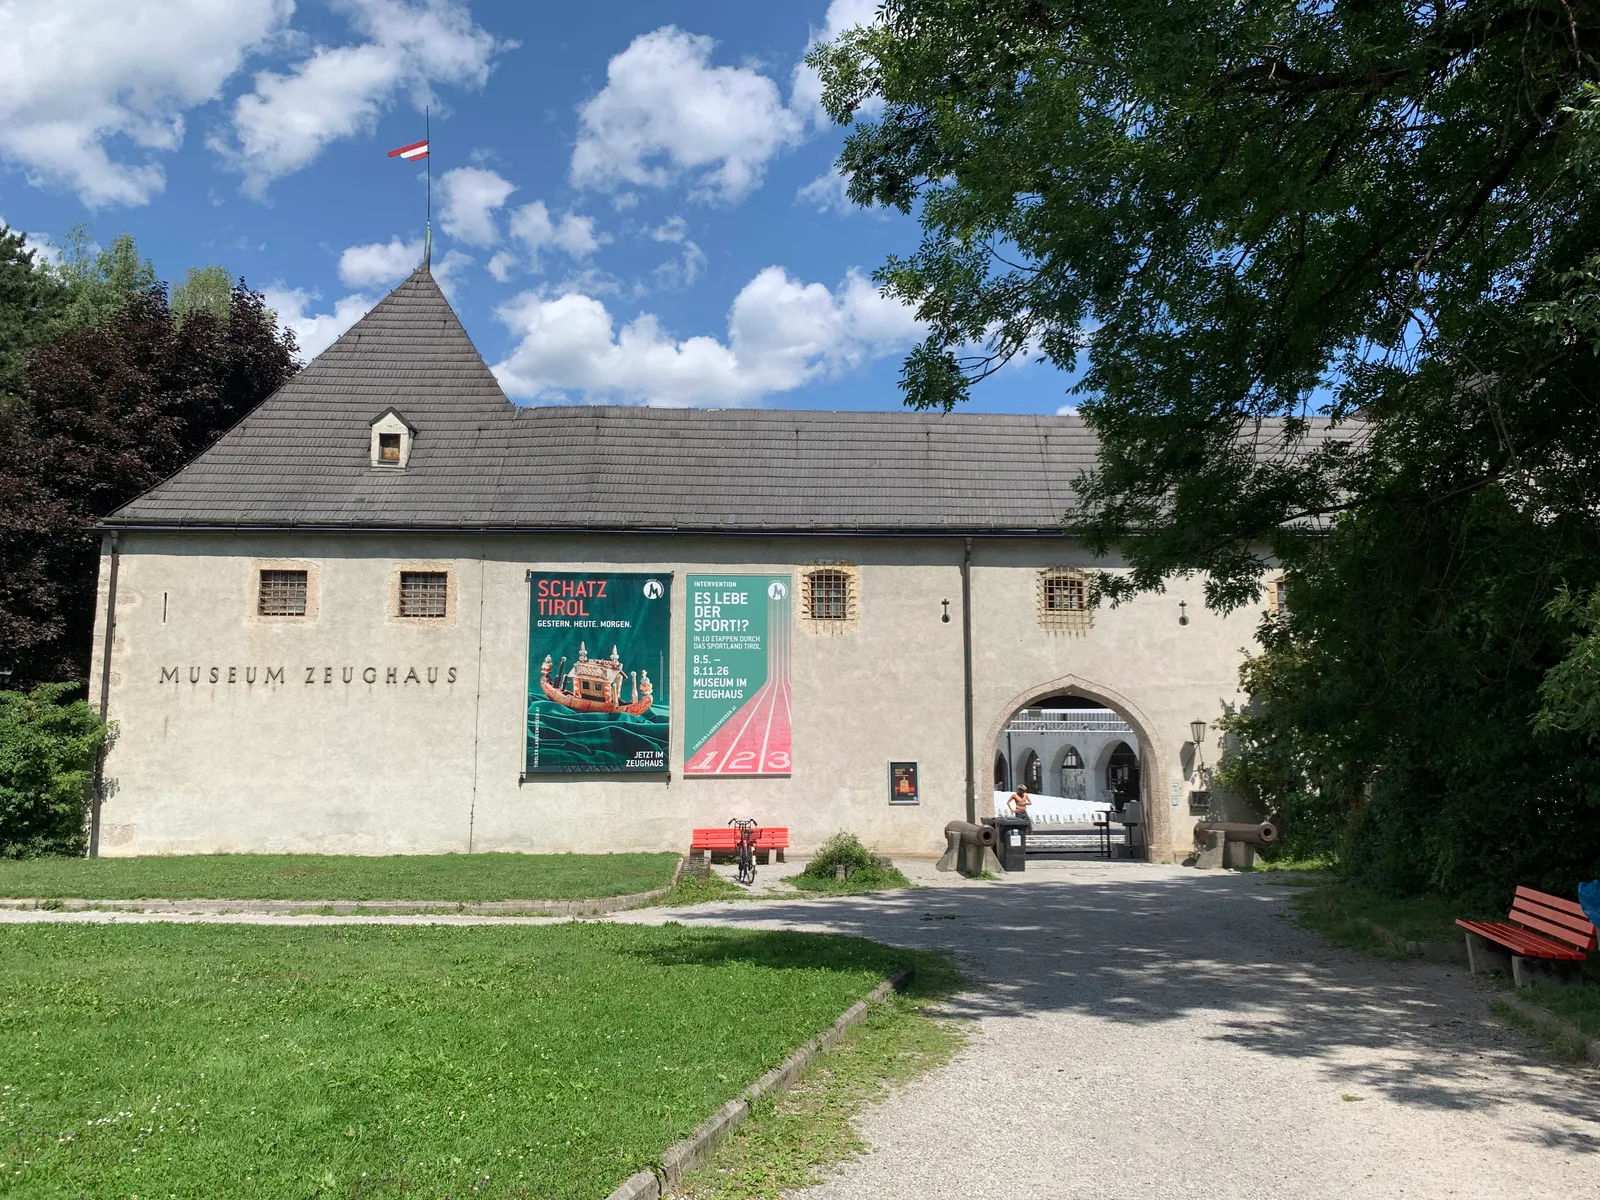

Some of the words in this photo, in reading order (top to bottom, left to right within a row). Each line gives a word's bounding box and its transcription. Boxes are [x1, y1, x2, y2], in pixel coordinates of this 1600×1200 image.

[538, 580, 607, 597] SCHATZ
[694, 592, 711, 604] ES
[715, 592, 748, 604] LEBE
[538, 599, 589, 616] TIROL
[694, 606, 720, 618] DER
[537, 620, 572, 628] GESTERN.
[694, 620, 749, 632] SPORT!?
[694, 655, 711, 664] 8.5.
[159, 666, 285, 684] MUSEUM
[305, 666, 458, 684] ZEUGHAUS
[694, 667, 729, 675] 8.11.26
[693, 678, 733, 687] MUSEUM
[736, 678, 747, 687] IM
[693, 690, 743, 699] ZEUGHAUS
[634, 751, 653, 759] JETZT
[690, 751, 719, 769] 1
[727, 752, 756, 769] 2
[768, 752, 791, 769] 3
